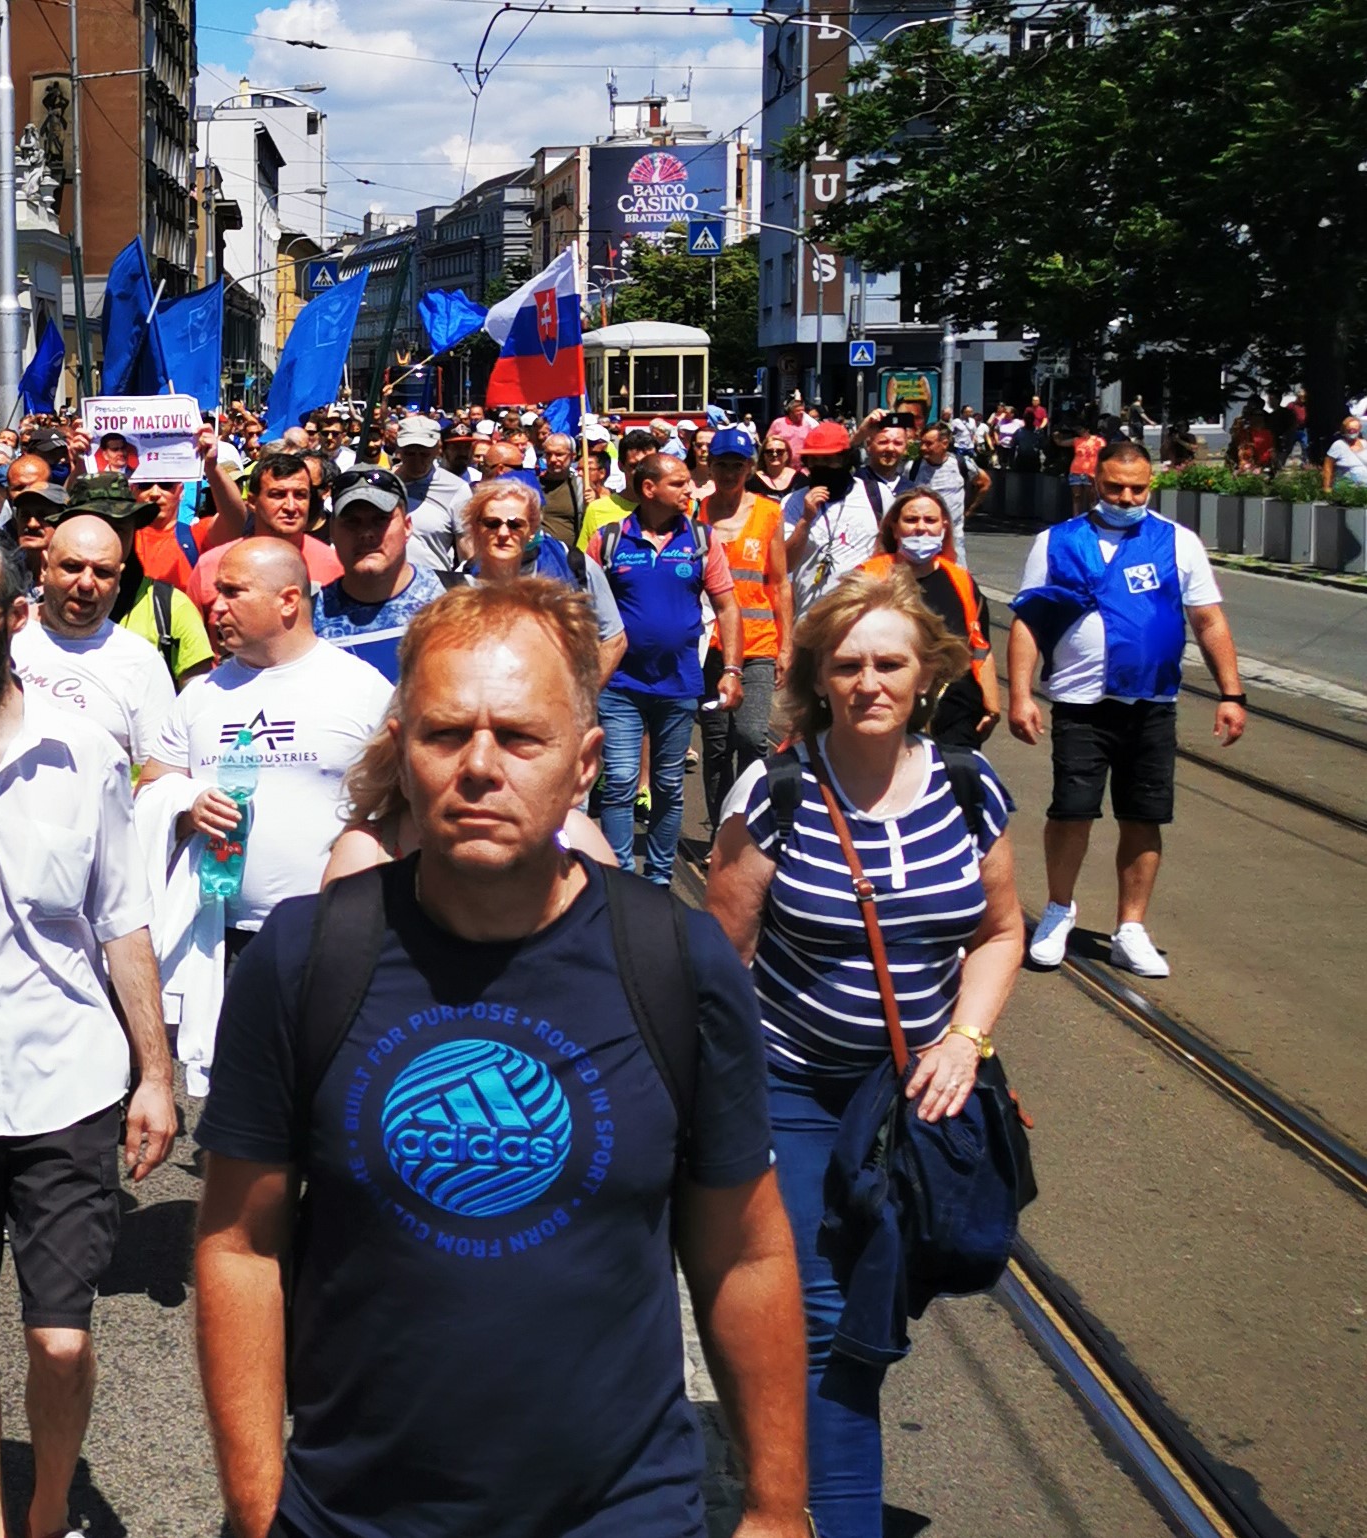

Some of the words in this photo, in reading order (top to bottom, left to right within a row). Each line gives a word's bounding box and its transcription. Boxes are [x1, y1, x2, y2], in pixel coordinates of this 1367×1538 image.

[617, 193, 699, 213] CASINO
[633, 184, 686, 197] BANCO
[624, 213, 691, 223] BRATISLAVA
[94, 415, 128, 431] STOP
[240, 752, 318, 764] INDUSTRIES
[408, 1001, 519, 1033] PURPOSE
[367, 1026, 407, 1066] FOR
[344, 1065, 372, 1131] BUILT
[589, 1087, 611, 1114] IN
[396, 1124, 554, 1164] adidas
[581, 1119, 615, 1195] SPORT
[509, 1207, 571, 1253] BORN
[436, 1231, 502, 1258] FROM
